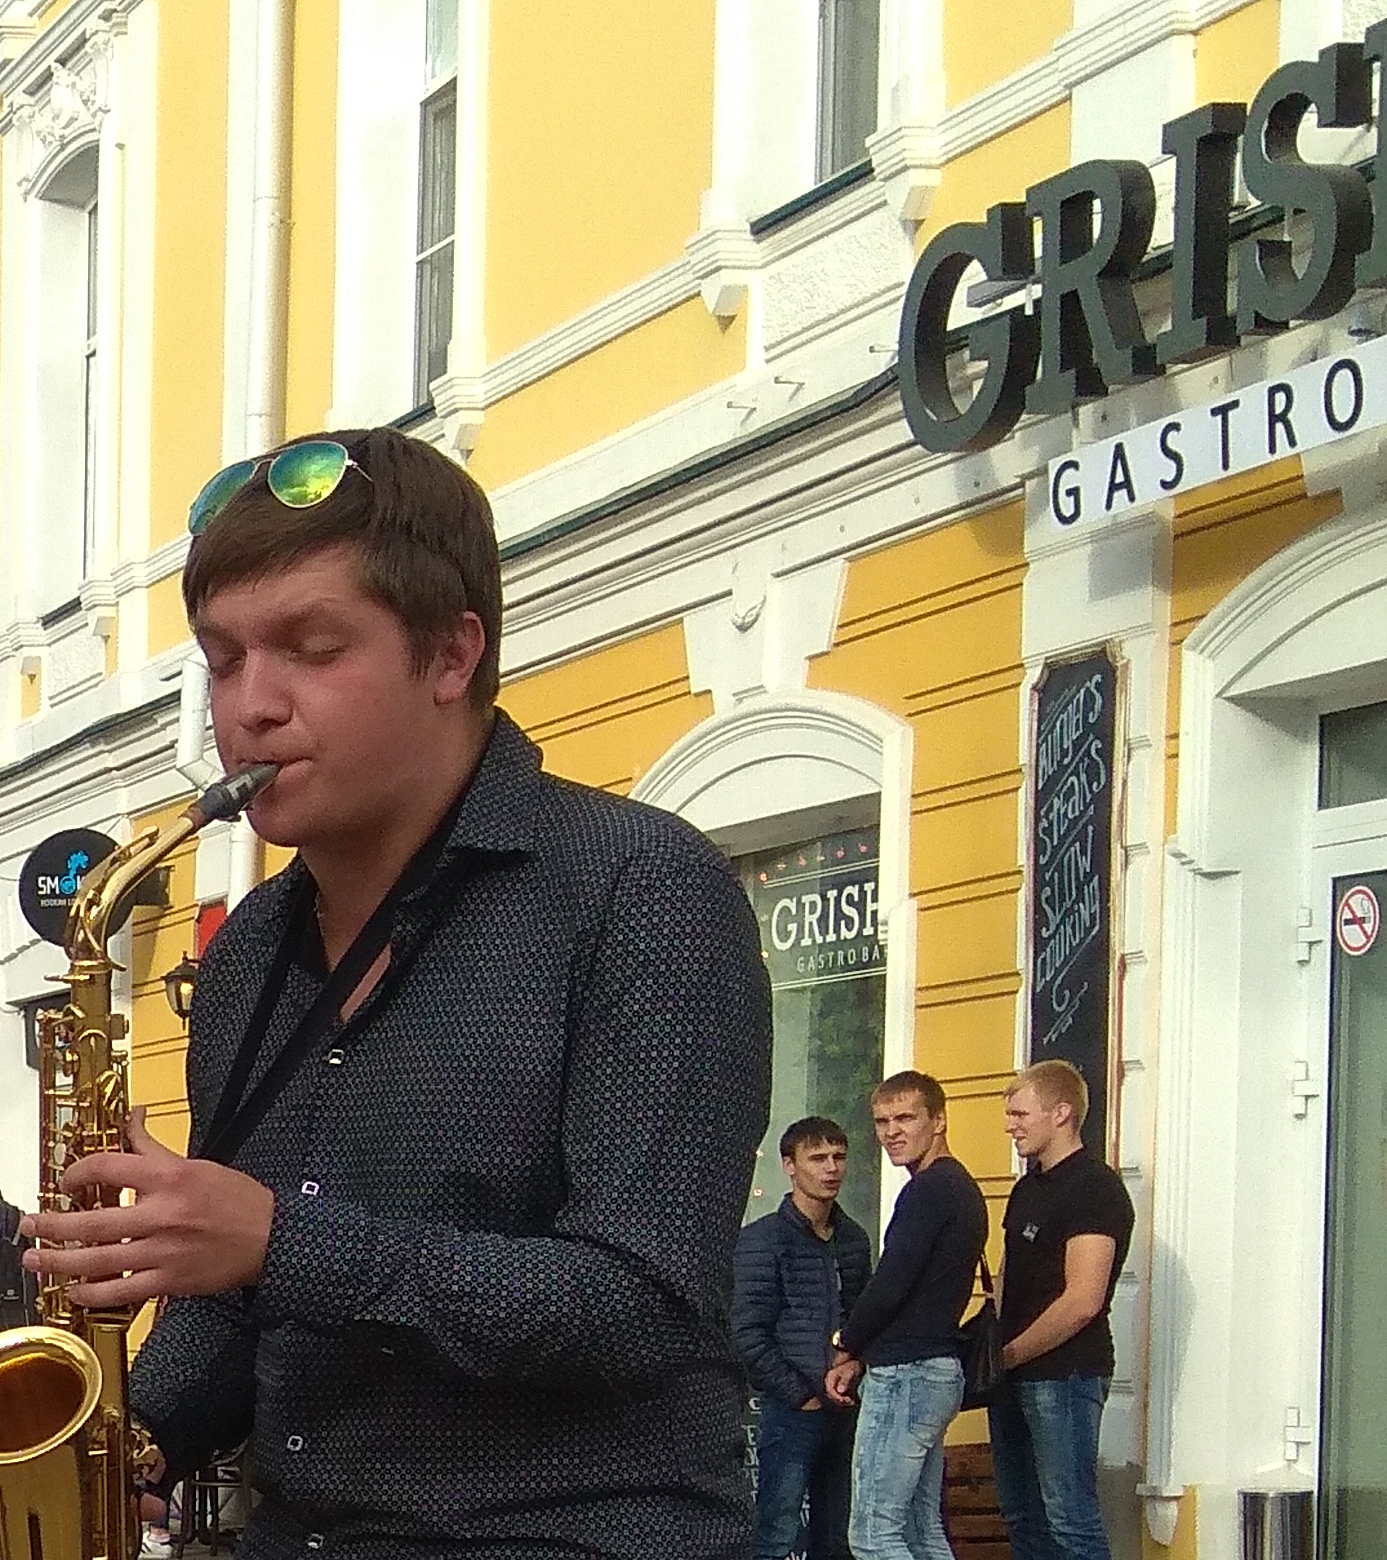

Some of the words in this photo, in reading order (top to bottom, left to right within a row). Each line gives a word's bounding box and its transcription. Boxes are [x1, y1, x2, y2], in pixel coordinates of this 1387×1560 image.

[1051, 358, 1365, 526] GASTRO
[1041, 825, 1094, 938] SLOW
[797, 949, 857, 972] GASTRO
[862, 944, 888, 963] BA
